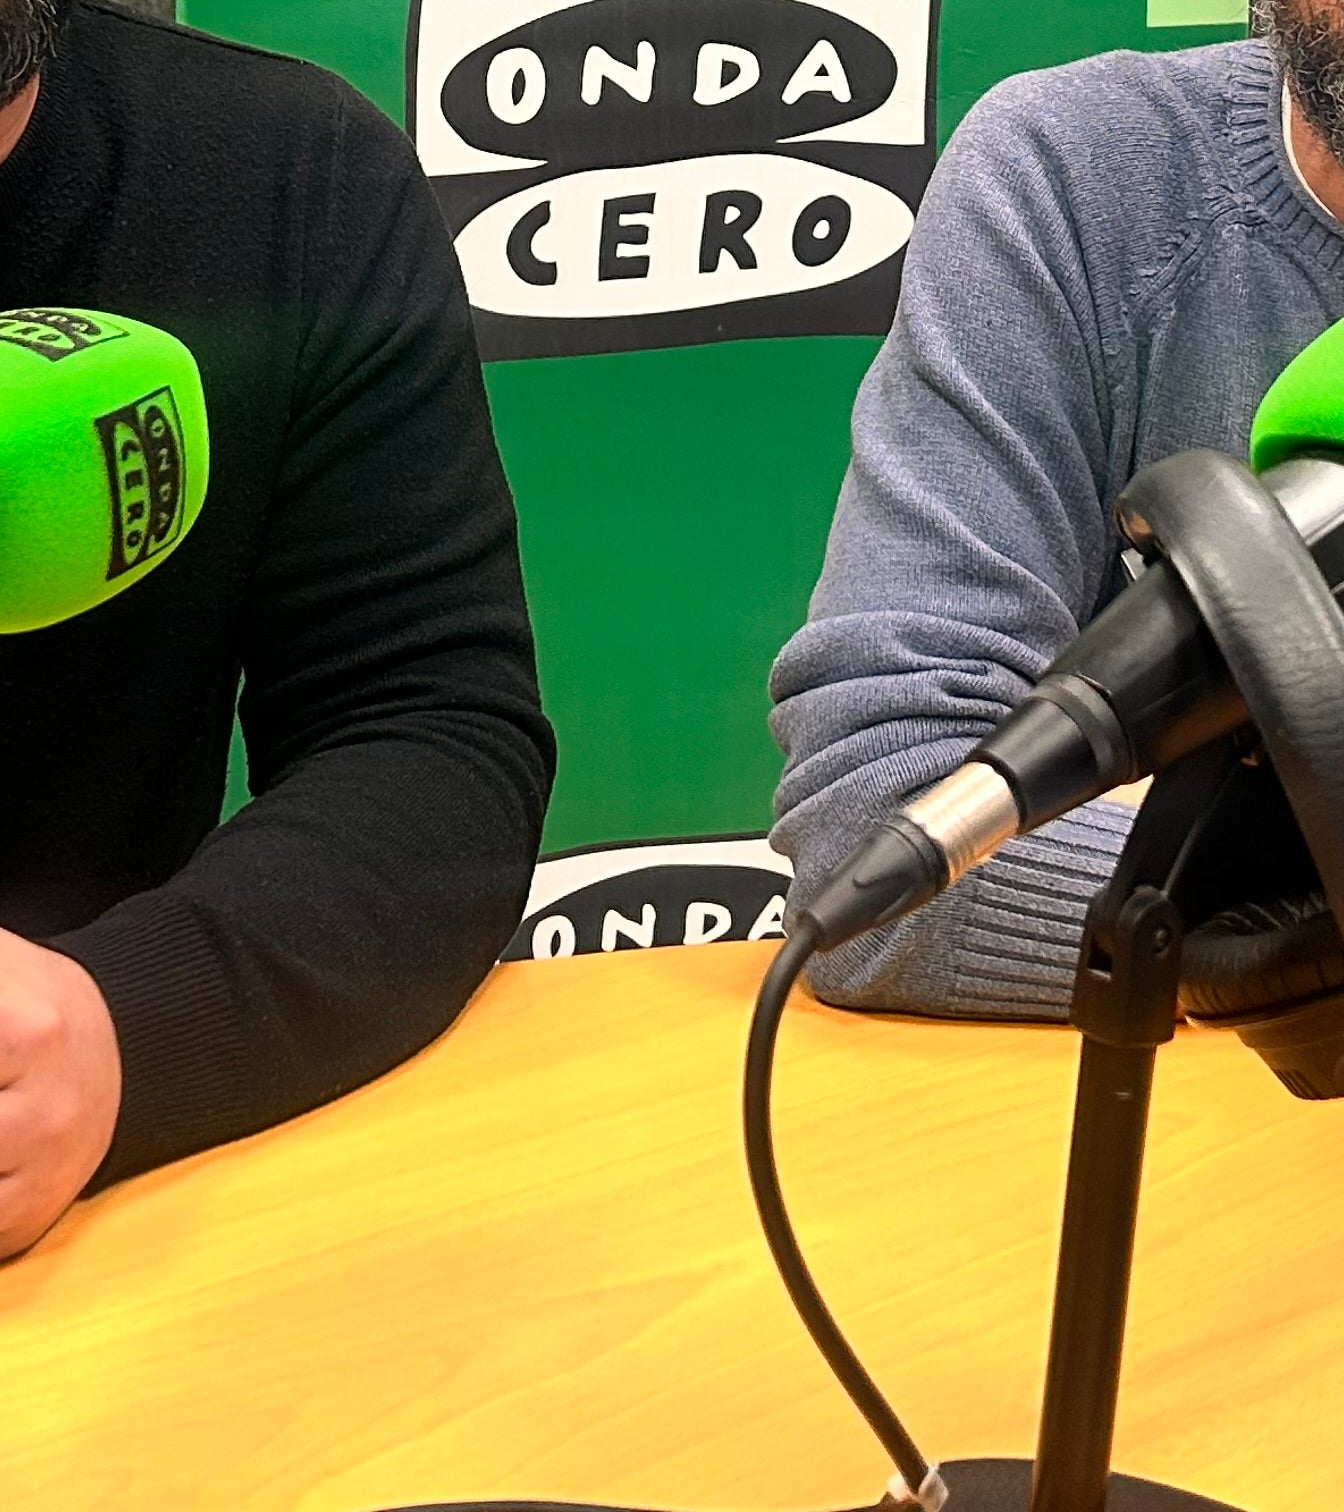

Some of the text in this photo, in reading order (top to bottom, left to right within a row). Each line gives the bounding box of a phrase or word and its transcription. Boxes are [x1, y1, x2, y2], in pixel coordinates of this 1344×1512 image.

[485, 39, 852, 124] ONDA
[506, 190, 852, 285] CERO
[121, 440, 144, 547] CERO
[531, 894, 788, 960] ONDA
